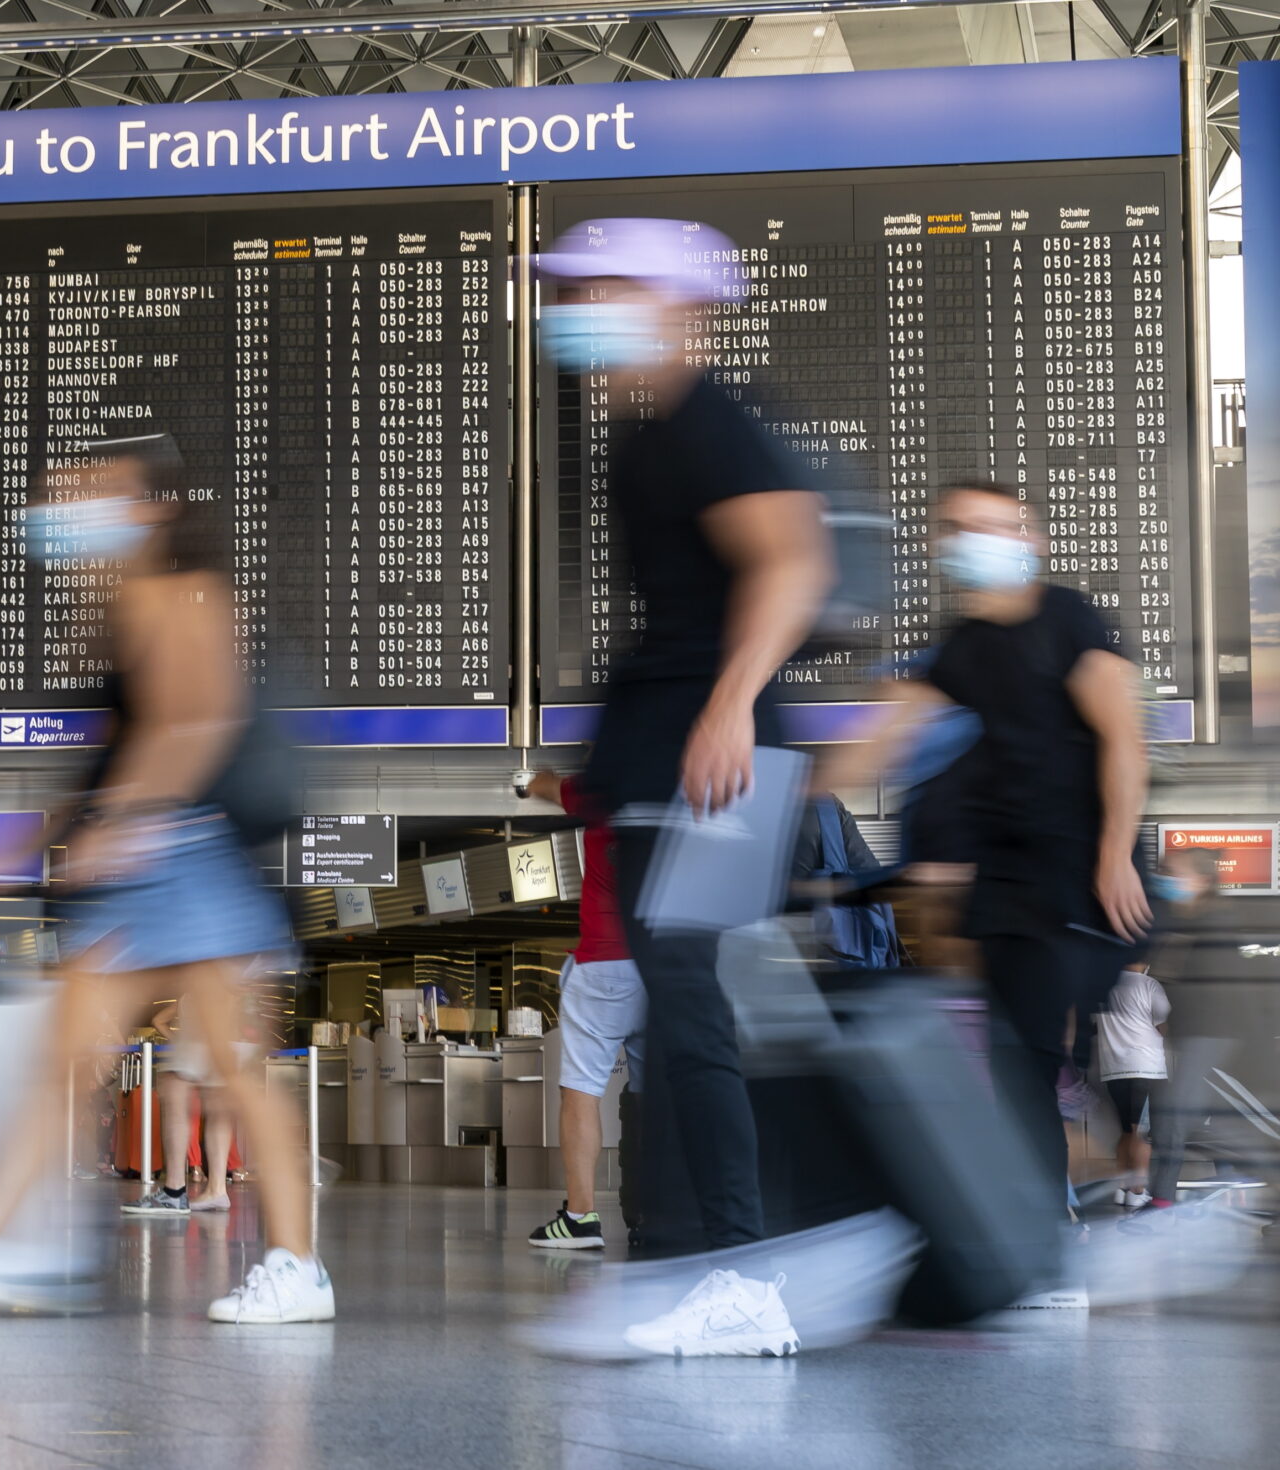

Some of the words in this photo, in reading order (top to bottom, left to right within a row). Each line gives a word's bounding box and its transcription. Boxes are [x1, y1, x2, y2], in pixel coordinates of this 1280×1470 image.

[35, 128, 96, 174] to
[120, 111, 388, 171] Frankfurt
[406, 102, 636, 171] Airport
[274, 238, 307, 248] erwartet
[313, 236, 341, 246] Terminal
[351, 236, 368, 245] Halle
[398, 233, 427, 243] Schalter
[460, 231, 491, 243] Flugsteig
[1132, 234, 1160, 248] A14
[48, 246, 64, 256] nach
[126, 243, 142, 253] über
[233, 239, 268, 251] planmäßig
[314, 247, 343, 257] Terminal
[351, 246, 365, 256] Hall
[398, 244, 426, 254] Counter
[460, 243, 477, 252] Gate
[127, 255, 137, 264] via
[233, 250, 268, 260] scheduled
[274, 248, 310, 258] estimated
[684, 248, 769, 263] NUERNBERG
[1133, 252, 1161, 265] A24
[48, 258, 56, 268] to
[49, 273, 98, 287] MUMBAI
[1133, 269, 1161, 283] A50
[49, 289, 135, 304] KYJIV/KIEW
[146, 286, 215, 301] BORYSPIL
[1134, 287, 1162, 301] B24
[49, 304, 180, 320] TORONTO-PEARSON
[1135, 305, 1162, 319] B27
[48, 323, 99, 337] MADRID
[685, 318, 769, 333] EDINBURGH
[1135, 323, 1162, 337] A68
[49, 339, 117, 354] BUDAPEST
[685, 335, 769, 350] BARCELONA
[1135, 341, 1163, 355] B19
[48, 355, 143, 370] DUESSELDORF
[154, 354, 178, 367] HBF
[686, 352, 770, 367] REYKJAVIK
[1135, 358, 1163, 372] A25
[48, 372, 116, 387] HANNOVER
[1136, 376, 1164, 390] A62
[48, 390, 99, 404] BOSTON
[48, 405, 152, 420] TOKIO-HANEDA
[48, 423, 107, 437] FUNCHAL
[47, 440, 90, 454] NIZZA
[45, 541, 88, 554] MALTA
[45, 574, 123, 588] PODGORICA
[44, 609, 104, 622] GLASGOW
[44, 643, 86, 656] PORTO
[44, 677, 103, 690] HAMBURG
[29, 716, 64, 731] Abflug
[29, 729, 85, 743] Departures
[1189, 835, 1225, 843] TURKISH
[1226, 835, 1263, 843] AIRLINES
[530, 865, 551, 877] Frankfurt
[531, 874, 547, 887] Airport
